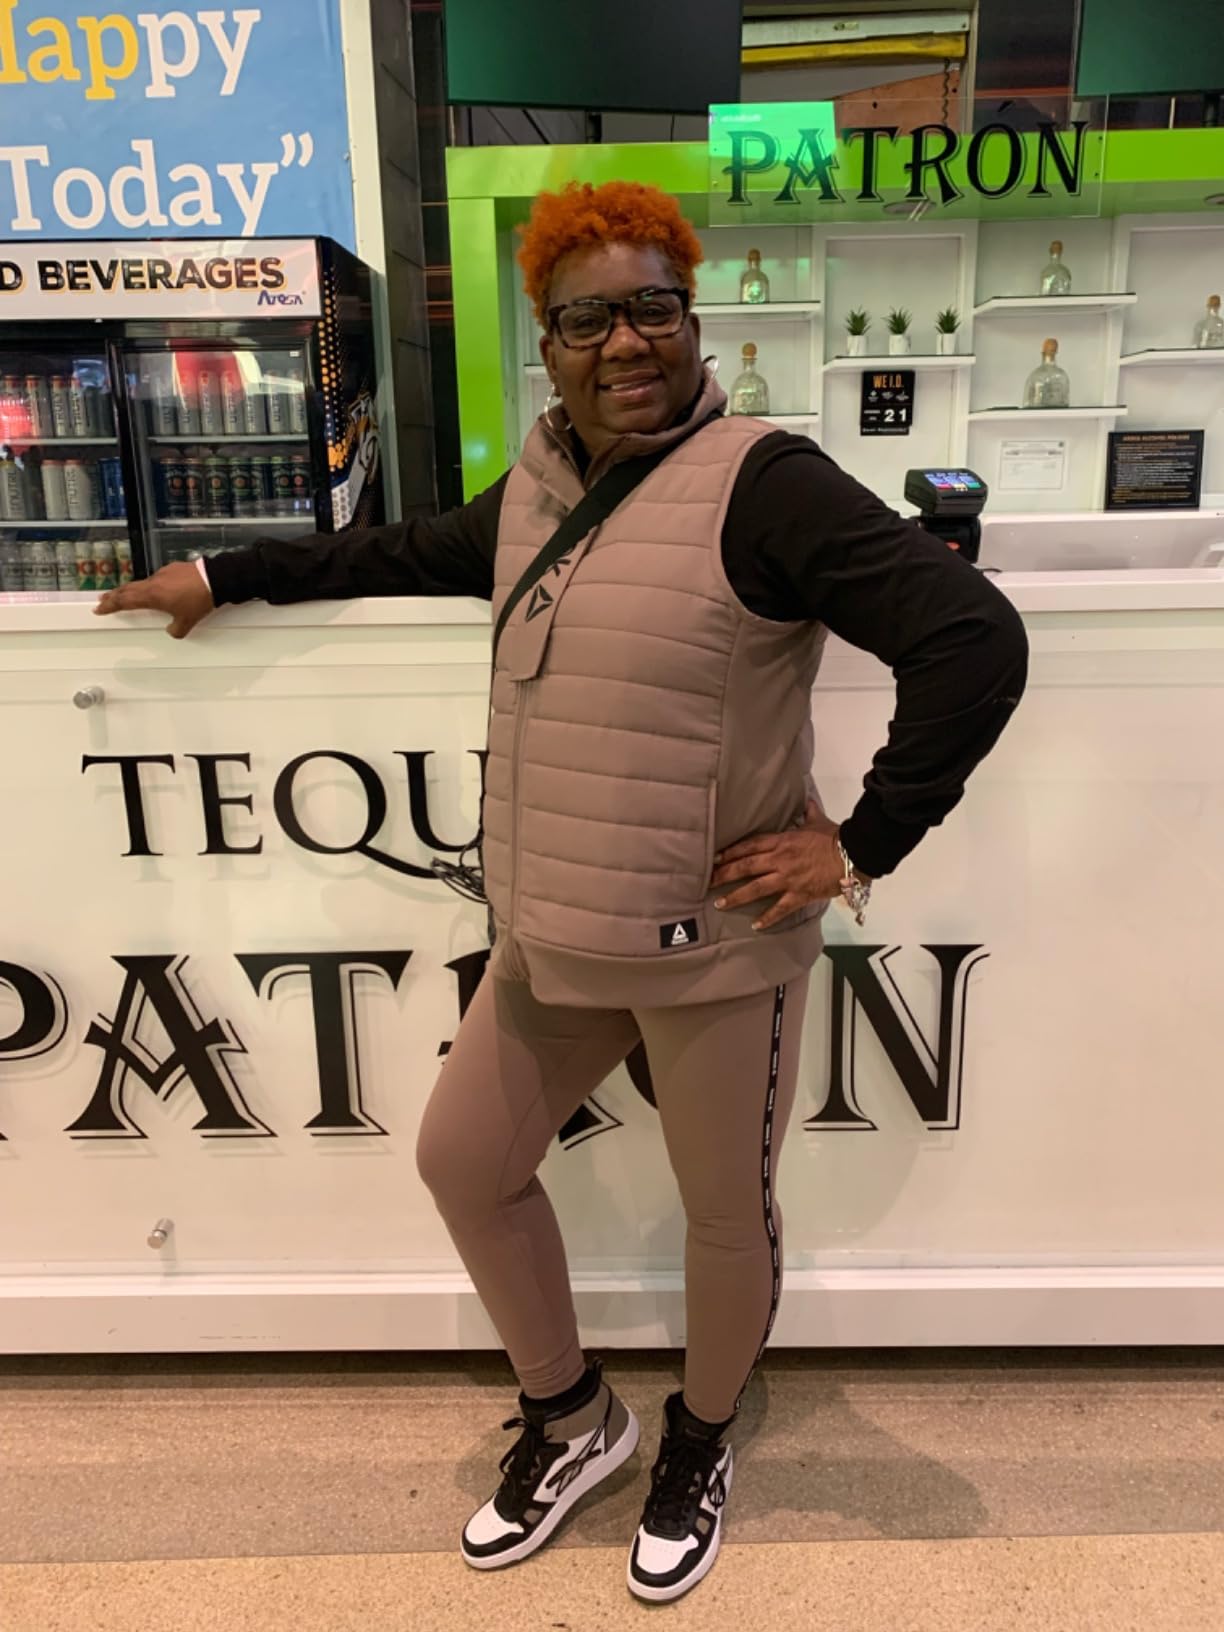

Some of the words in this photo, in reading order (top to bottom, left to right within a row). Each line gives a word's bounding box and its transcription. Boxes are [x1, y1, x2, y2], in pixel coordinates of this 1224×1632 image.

[37, 257, 286, 291] BEVERAGES
[873, 374, 887, 388] WE
[884, 408, 907, 422] 21
